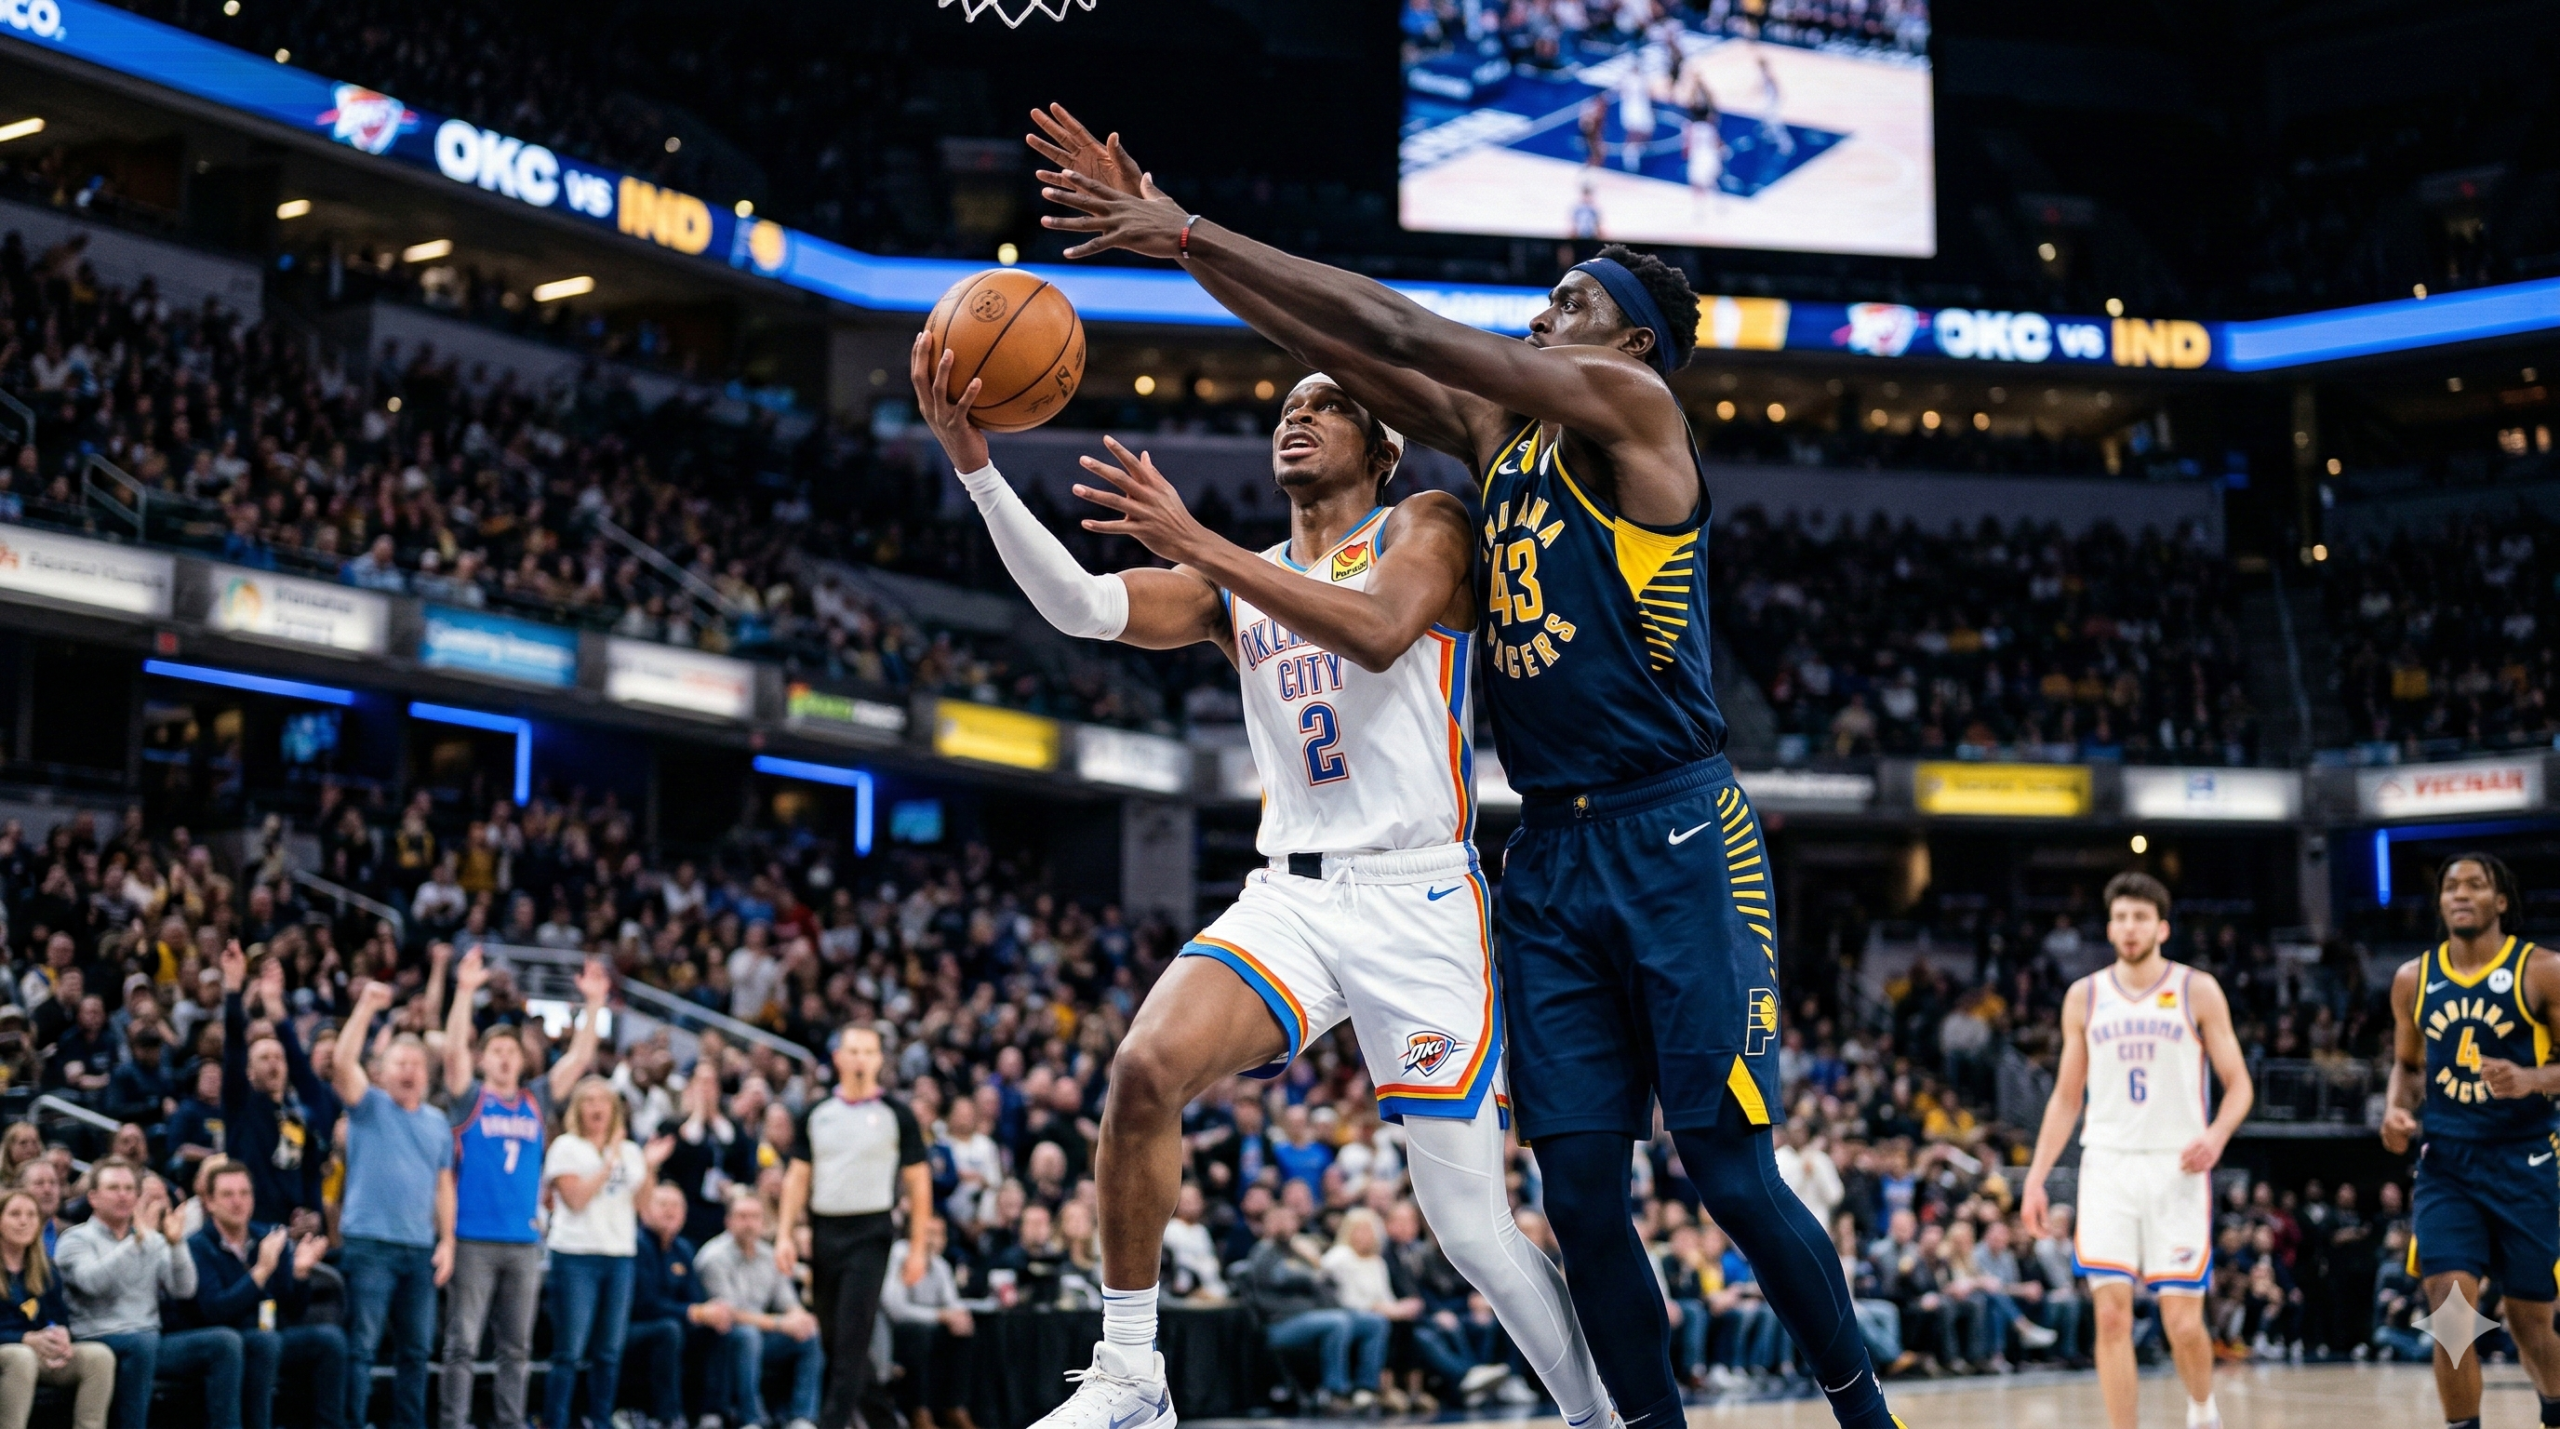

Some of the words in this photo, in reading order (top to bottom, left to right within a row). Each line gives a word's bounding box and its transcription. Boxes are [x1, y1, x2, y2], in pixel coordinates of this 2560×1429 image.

[434, 119, 560, 207] OKC
[617, 175, 713, 255] IND
[1933, 307, 2052, 363] OKC
[2111, 317, 2211, 369] IND
[1490, 537, 1544, 627] 43
[1276, 649, 1343, 702] CITY
[1298, 701, 1350, 787] 2
[2424, 997, 2516, 1041] INDIANA
[2117, 1042, 2156, 1061] CITY
[2455, 1026, 2482, 1075] 4
[2128, 1066, 2148, 1104] 6
[2435, 1065, 2494, 1105] PACE
